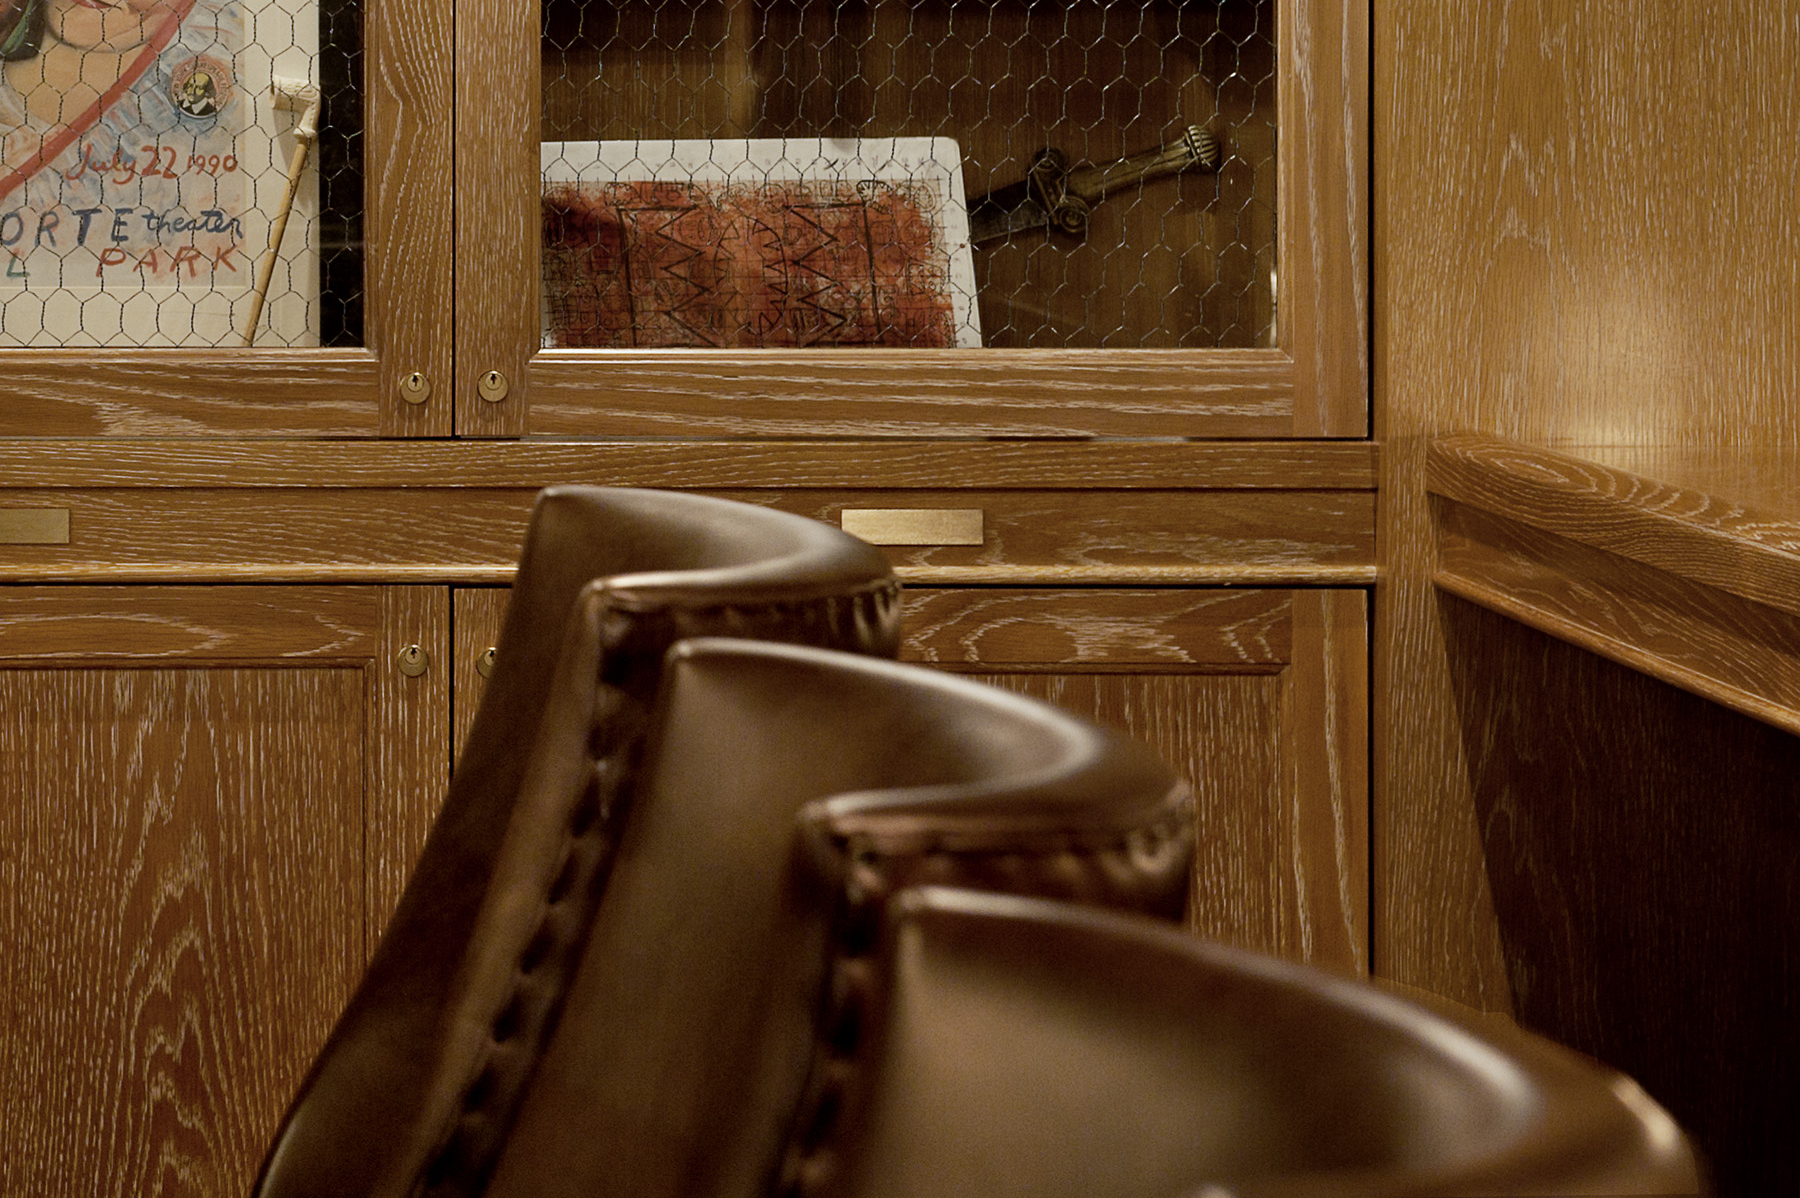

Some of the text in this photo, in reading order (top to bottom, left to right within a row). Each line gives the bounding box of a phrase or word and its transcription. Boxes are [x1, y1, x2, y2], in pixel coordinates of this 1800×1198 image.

[65, 143, 137, 184] July
[141, 145, 178, 178] 22
[186, 155, 238, 175] 1990
[142, 209, 243, 239] theater
[96, 246, 238, 277] PARK
